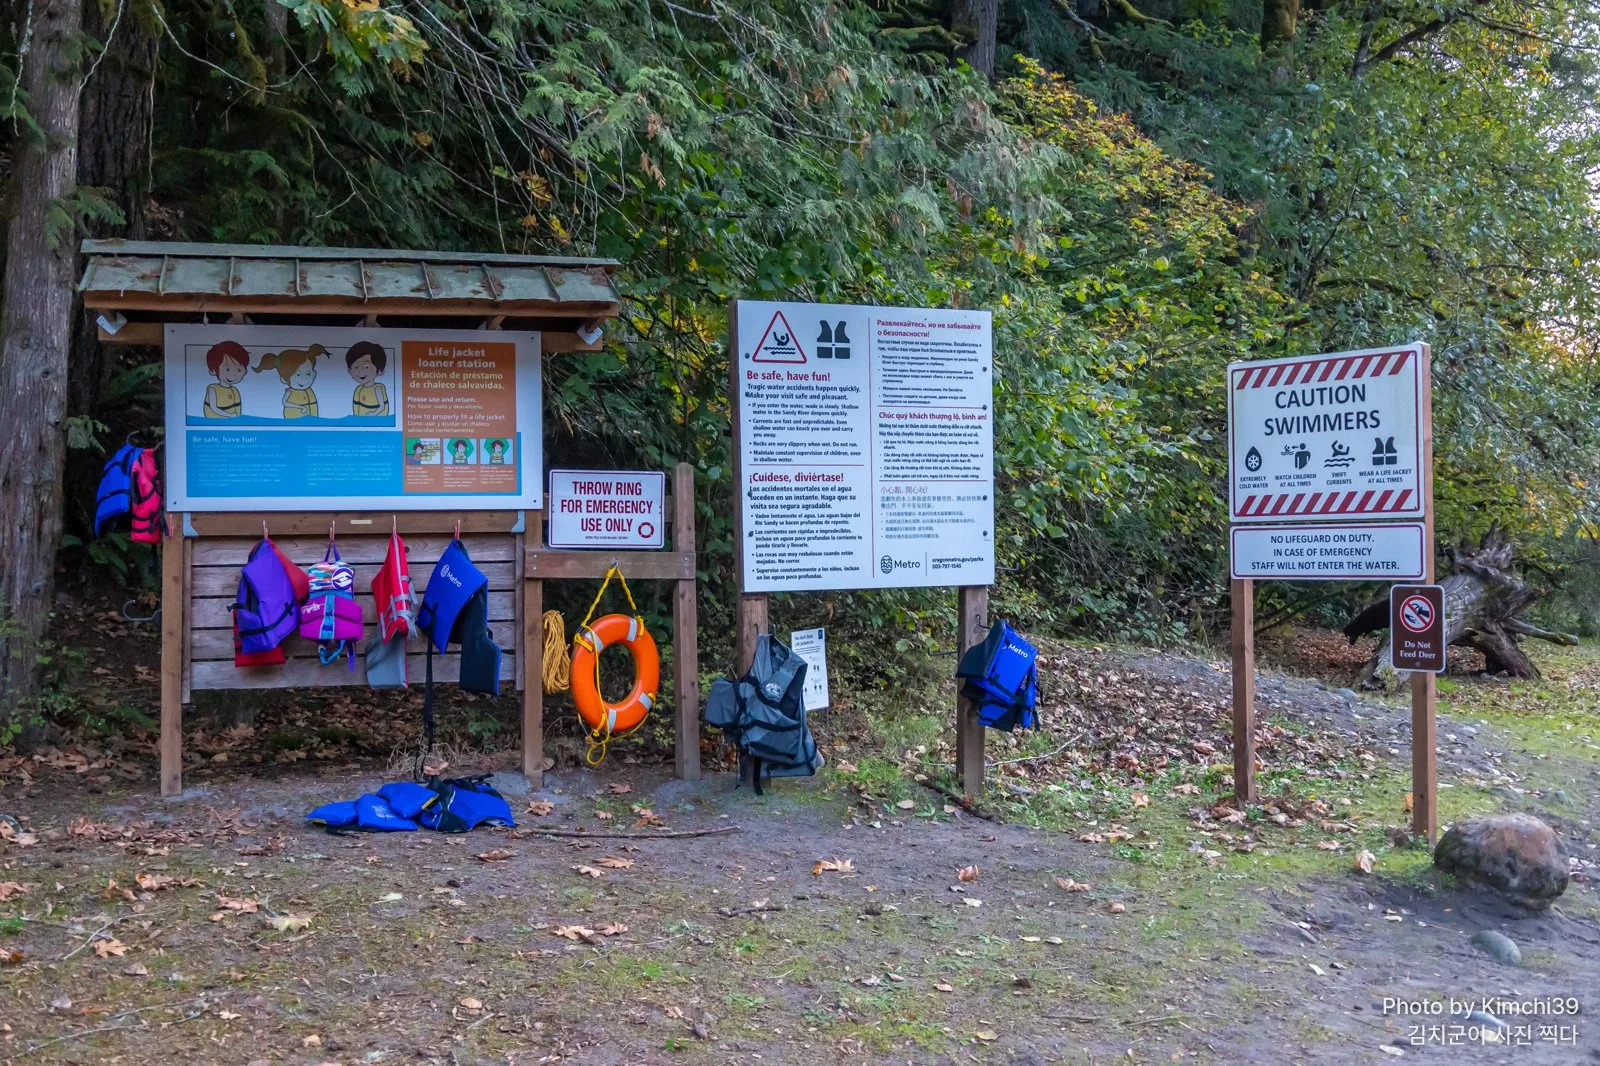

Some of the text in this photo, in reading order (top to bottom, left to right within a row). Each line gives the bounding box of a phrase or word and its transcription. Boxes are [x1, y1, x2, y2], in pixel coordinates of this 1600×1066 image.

[428, 347, 486, 358] Life jacket
[419, 358, 454, 367] loaner
[747, 370, 830, 381] Be safe, have fun!
[1275, 384, 1366, 409] CAUTION
[1264, 410, 1380, 436] SWIMMERS
[572, 481, 642, 495] THROW RING
[561, 500, 653, 514] FOR EMERGENCY
[581, 518, 633, 532] USE ONLY
[1271, 536, 1283, 544] NO
[1286, 535, 1330, 543] LIFEGUARD
[1348, 534, 1374, 543] DUTY.
[1284, 548, 1304, 556] CASE
[1319, 548, 1372, 556] EMERGENCY
[894, 560, 920, 568] Metro
[1252, 561, 1274, 570] STAFF
[1318, 561, 1344, 570] ENTER
[1347, 561, 1363, 570] THE
[1366, 561, 1400, 570] WATER.
[447, 572, 462, 587] Metro
[1008, 644, 1028, 658] Metro
